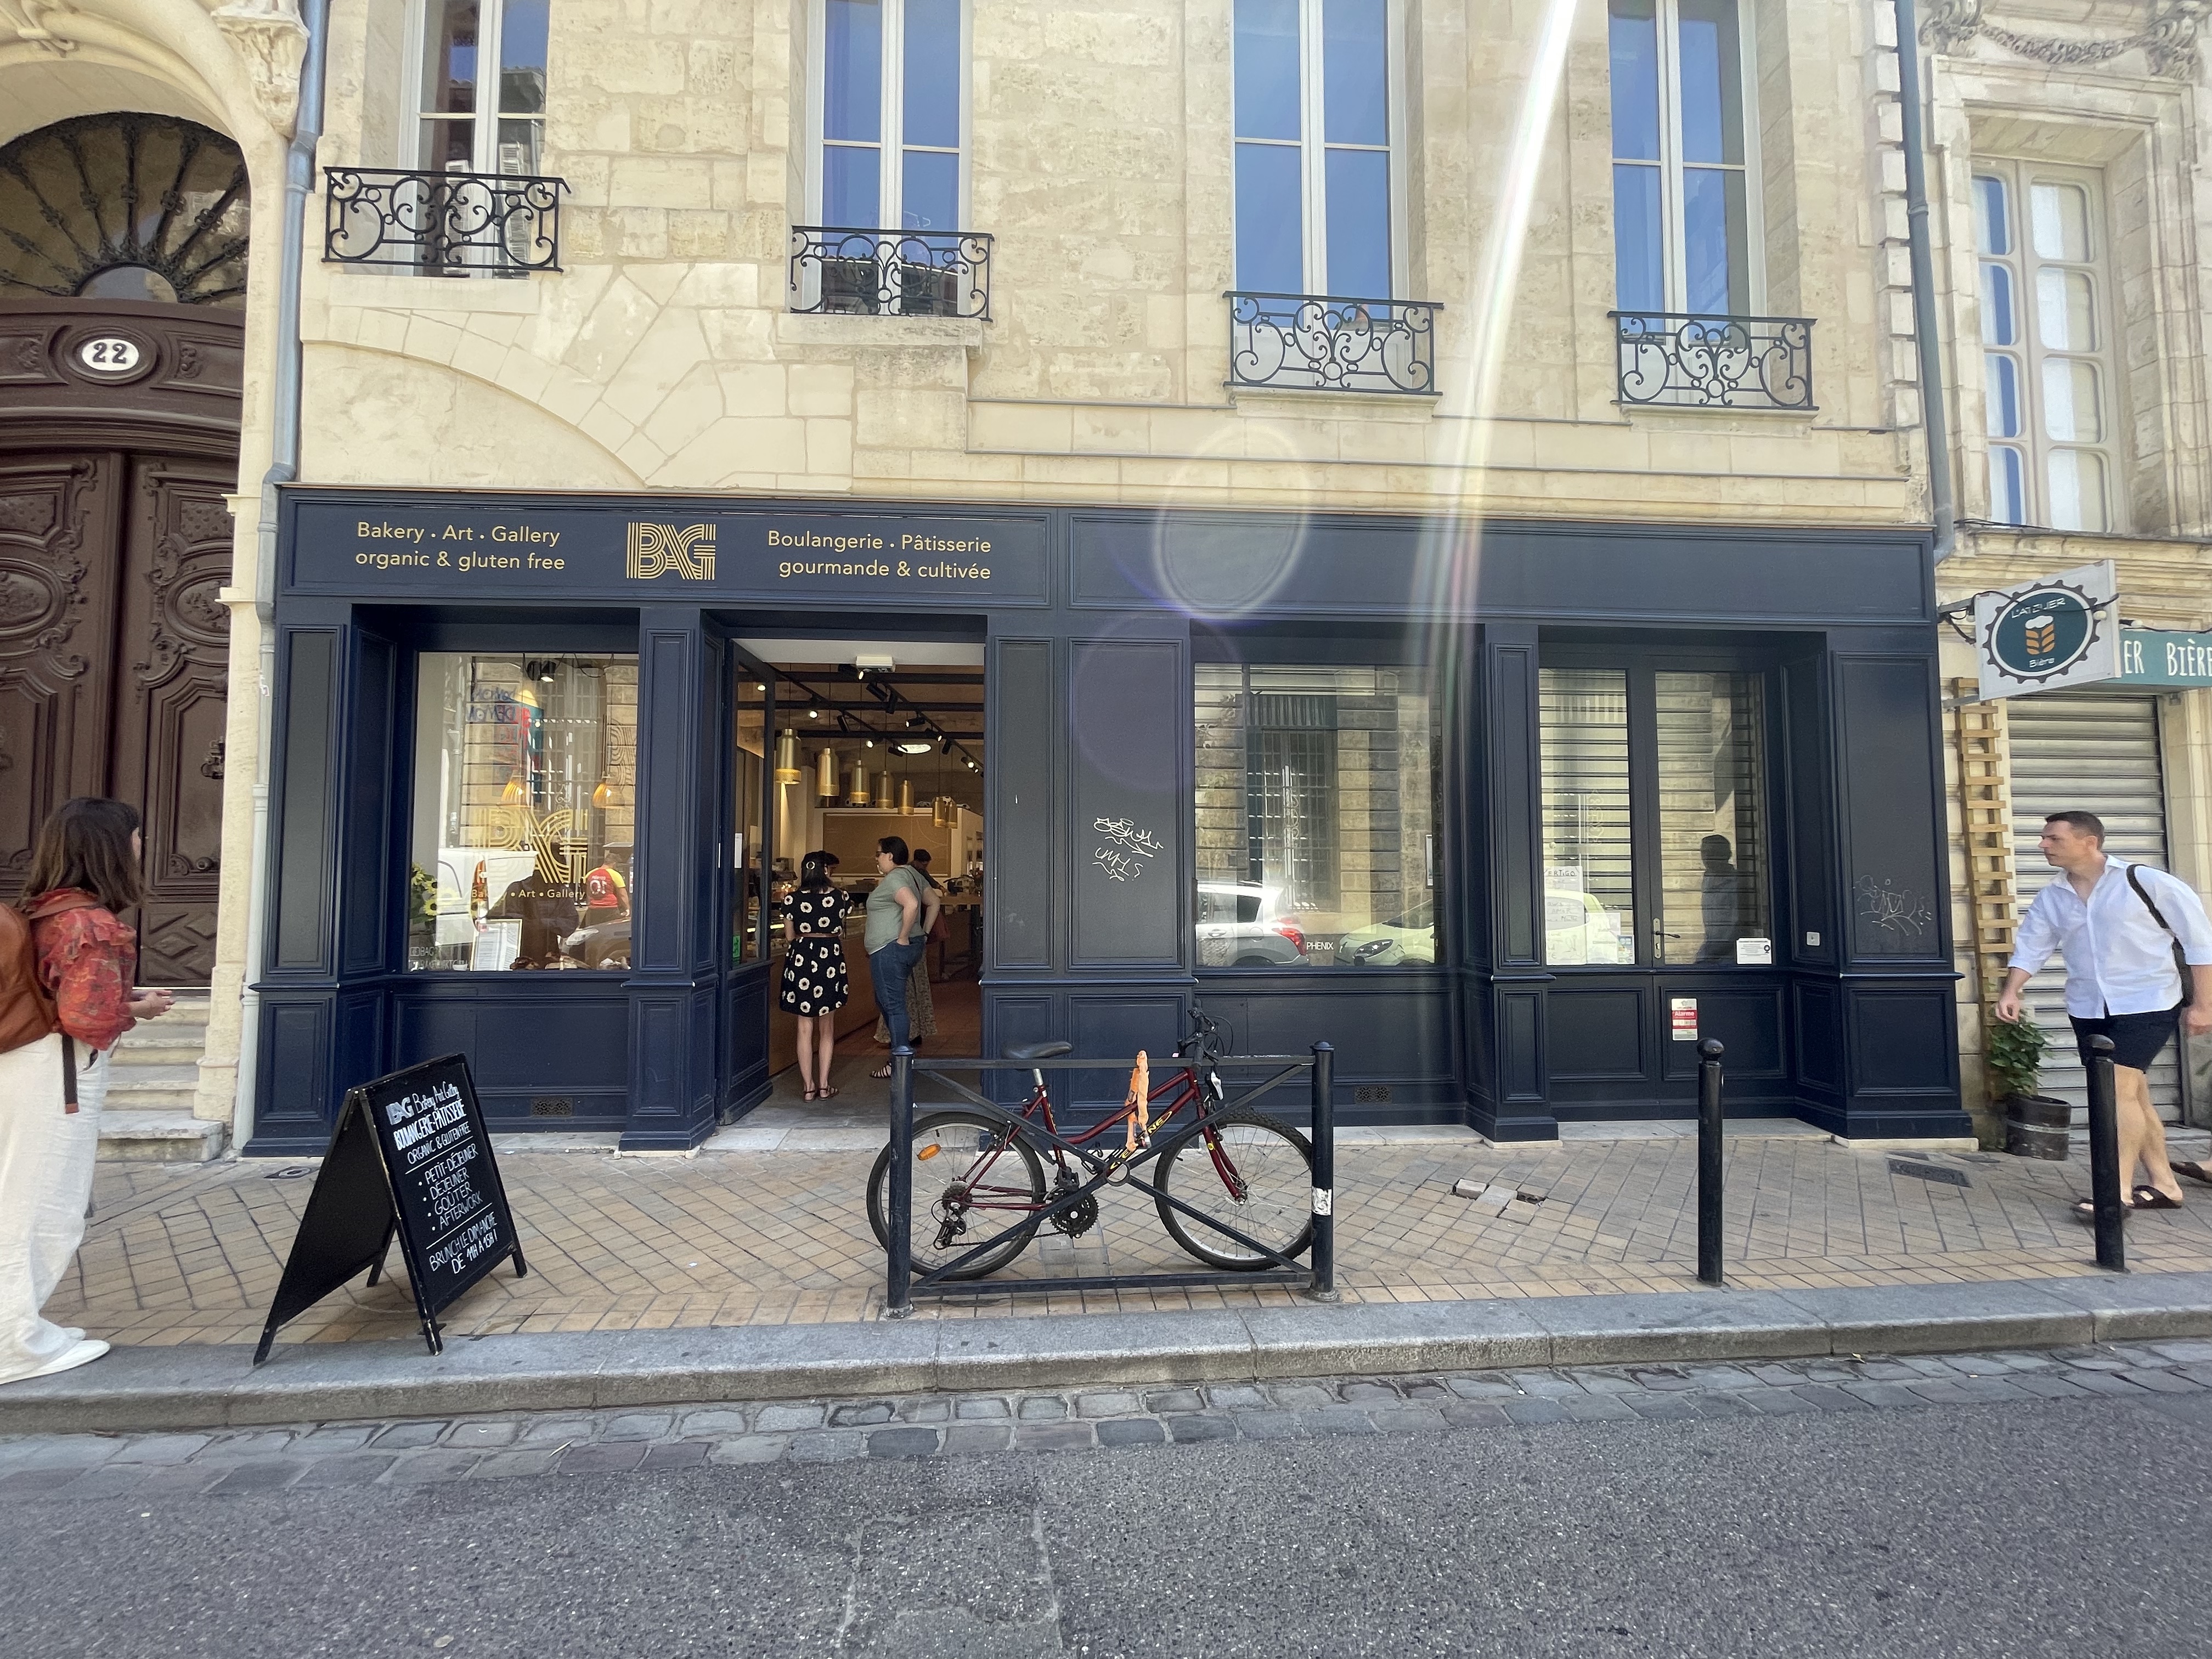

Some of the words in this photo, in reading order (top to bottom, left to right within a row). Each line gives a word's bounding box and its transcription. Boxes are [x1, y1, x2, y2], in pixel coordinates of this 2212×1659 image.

[92, 342, 127, 364] 22
[357, 521, 425, 543] Bakery
[442, 524, 473, 540] Art
[492, 526, 560, 547] Gallery
[768, 530, 883, 552] Boulangerie
[901, 534, 991, 552] Pâtisserie
[355, 550, 430, 569] organic
[436, 551, 452, 567] &
[458, 551, 520, 572] gluten
[527, 552, 566, 569] free
[626, 522, 716, 580] BAG
[778, 560, 890, 578] gourmande
[896, 561, 911, 577] &
[917, 562, 991, 579] cultivée
[518, 890, 535, 898] Art
[546, 889, 585, 900] Gallery
[1306, 941, 1334, 950] PHENIX
[385, 1097, 415, 1125] BAG
[407, 1140, 436, 1164] ORGANIC
[435, 1136, 443, 1149] &
[429, 1167, 470, 1200] DÉJEUNER
[434, 1181, 473, 1215] GOÛTER
[439, 1190, 483, 1231] AFTERWORK
[429, 1237, 462, 1272] BRUNCH
[451, 1252, 466, 1274] DE
